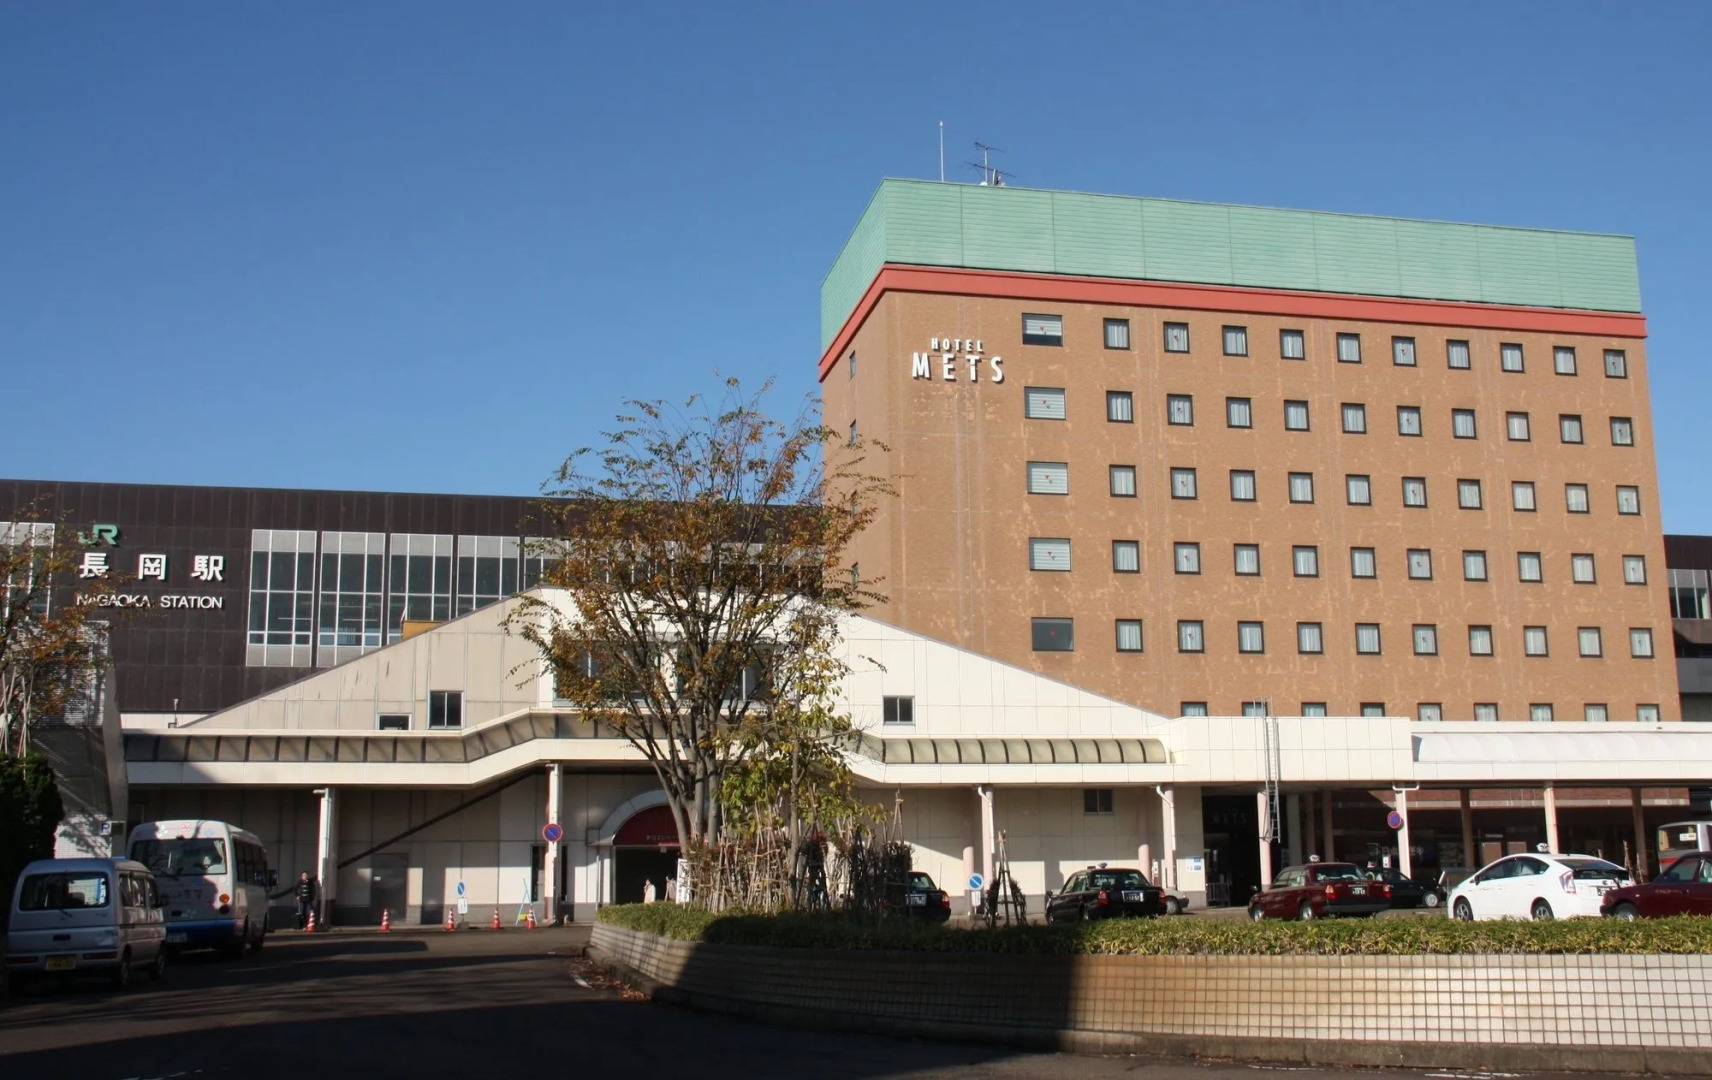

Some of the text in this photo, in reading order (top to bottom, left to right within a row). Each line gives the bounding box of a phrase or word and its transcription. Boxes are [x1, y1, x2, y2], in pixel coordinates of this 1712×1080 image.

[930, 337, 985, 353] HOTEL
[911, 351, 1005, 383] METS
[77, 523, 120, 546] JR
[78, 551, 225, 582] 長岡駅
[160, 594, 223, 609] STATION
